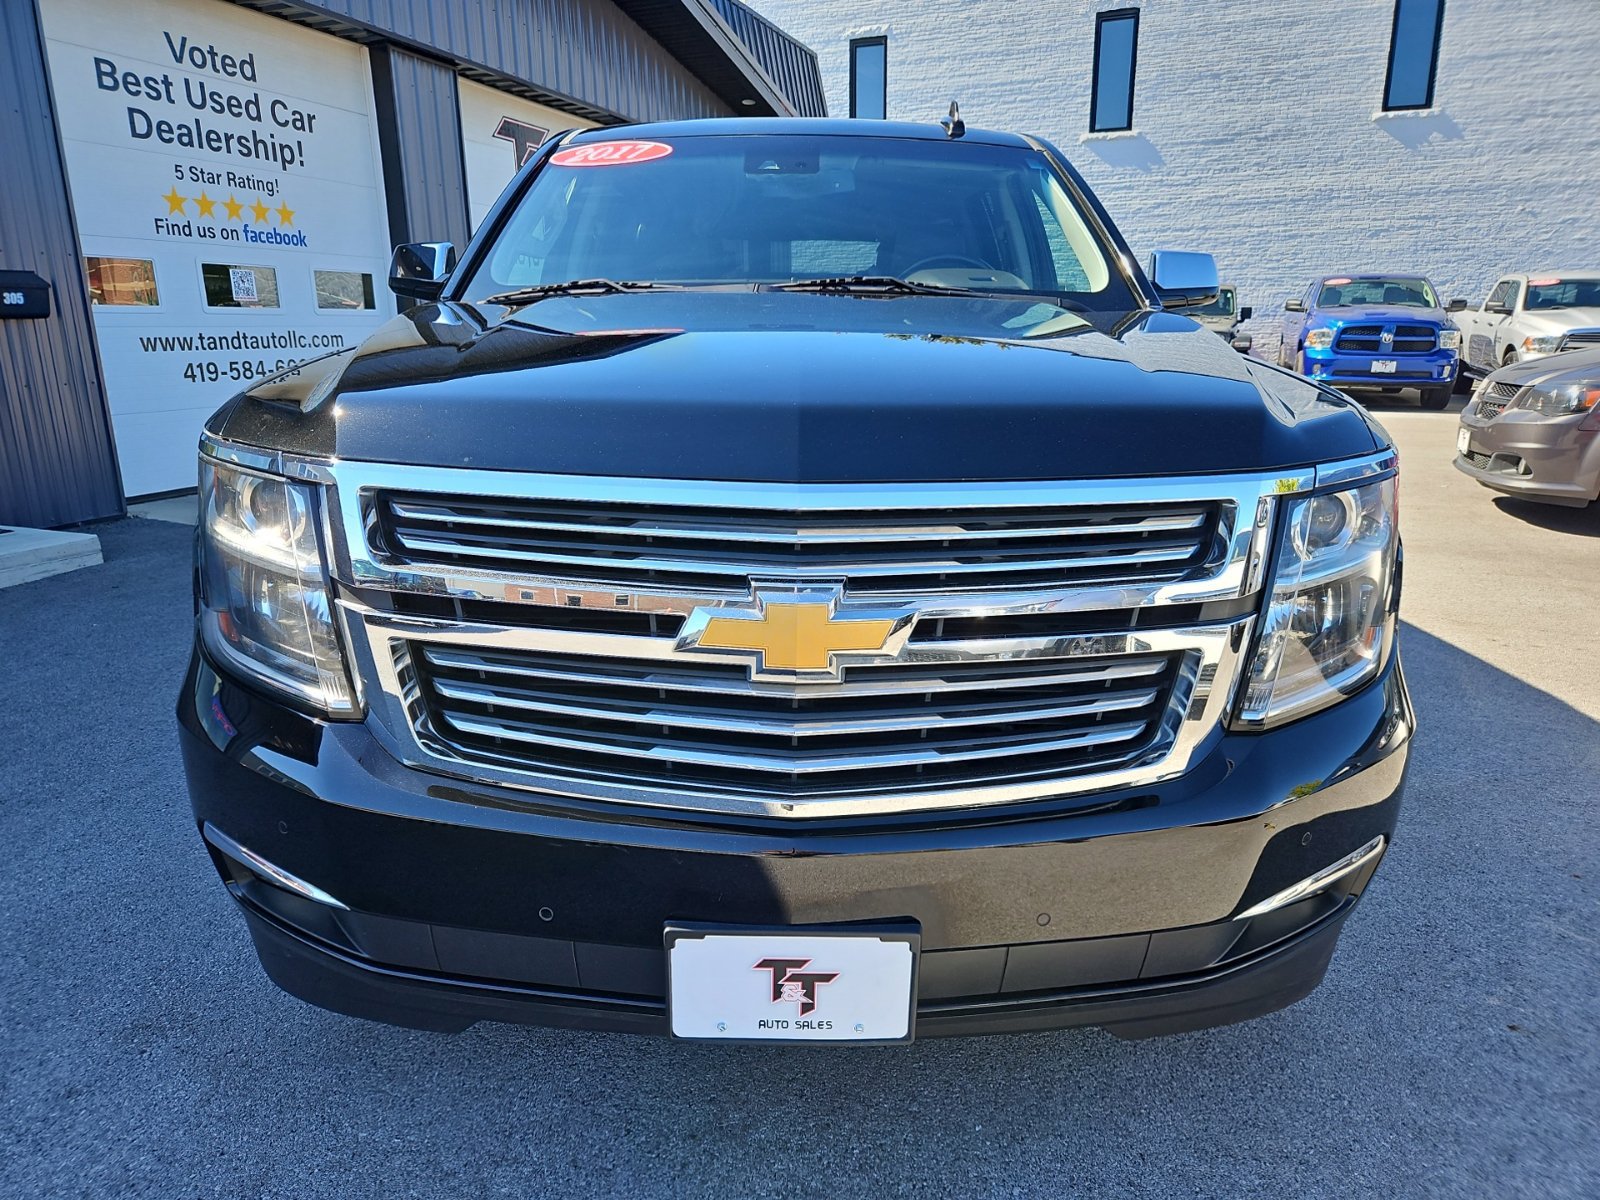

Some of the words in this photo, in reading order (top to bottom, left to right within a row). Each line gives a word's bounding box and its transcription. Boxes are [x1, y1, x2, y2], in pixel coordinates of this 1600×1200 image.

[163, 31, 257, 82] Voted
[93, 57, 176, 104] Best
[184, 78, 262, 122] Used
[270, 99, 316, 133] Car
[127, 106, 305, 171] Dealership!
[565, 144, 655, 163] 2017
[174, 164, 184, 180] 5
[190, 166, 222, 186] Star
[227, 172, 279, 197] Rating!
[154, 218, 192, 237] Find
[197, 226, 216, 239] us
[220, 228, 240, 241] on
[243, 224, 307, 247] facebook
[139, 331, 344, 352] www.tandtautollc.com
[752, 956, 840, 1017] T&T
[758, 1019, 789, 1030] AUTO
[795, 1020, 833, 1030] SALES
